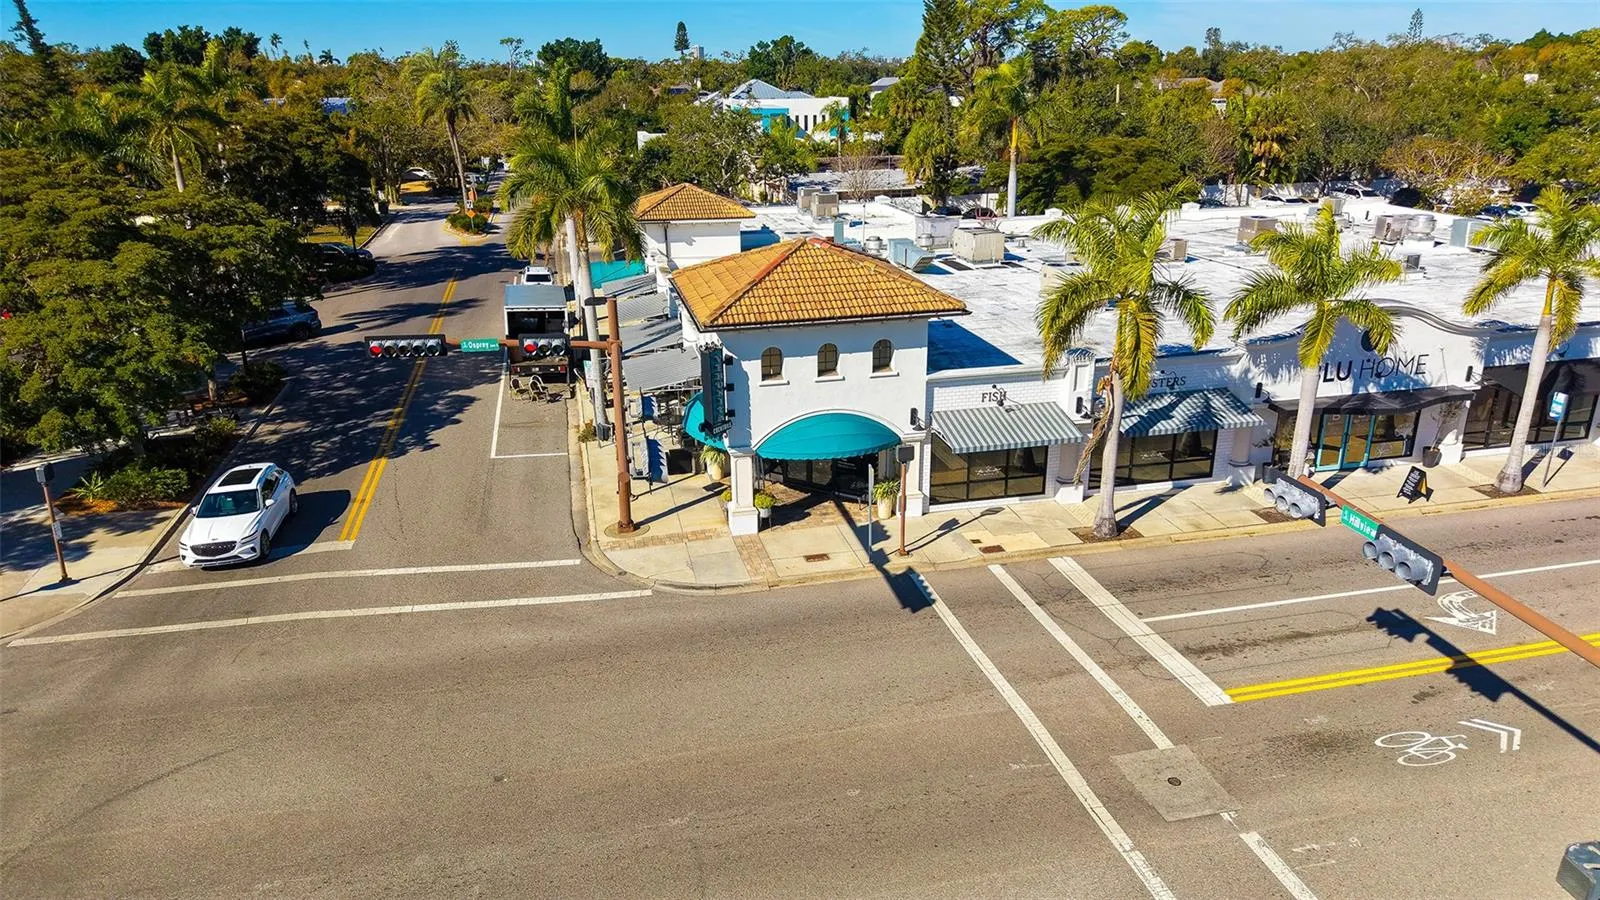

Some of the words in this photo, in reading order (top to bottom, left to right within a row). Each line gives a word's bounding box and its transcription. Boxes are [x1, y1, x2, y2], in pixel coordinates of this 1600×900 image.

[1319, 360, 1353, 382] LU
[1359, 354, 1429, 379] HOME
[1151, 375, 1187, 388] STERS
[981, 390, 1007, 402] FISH
